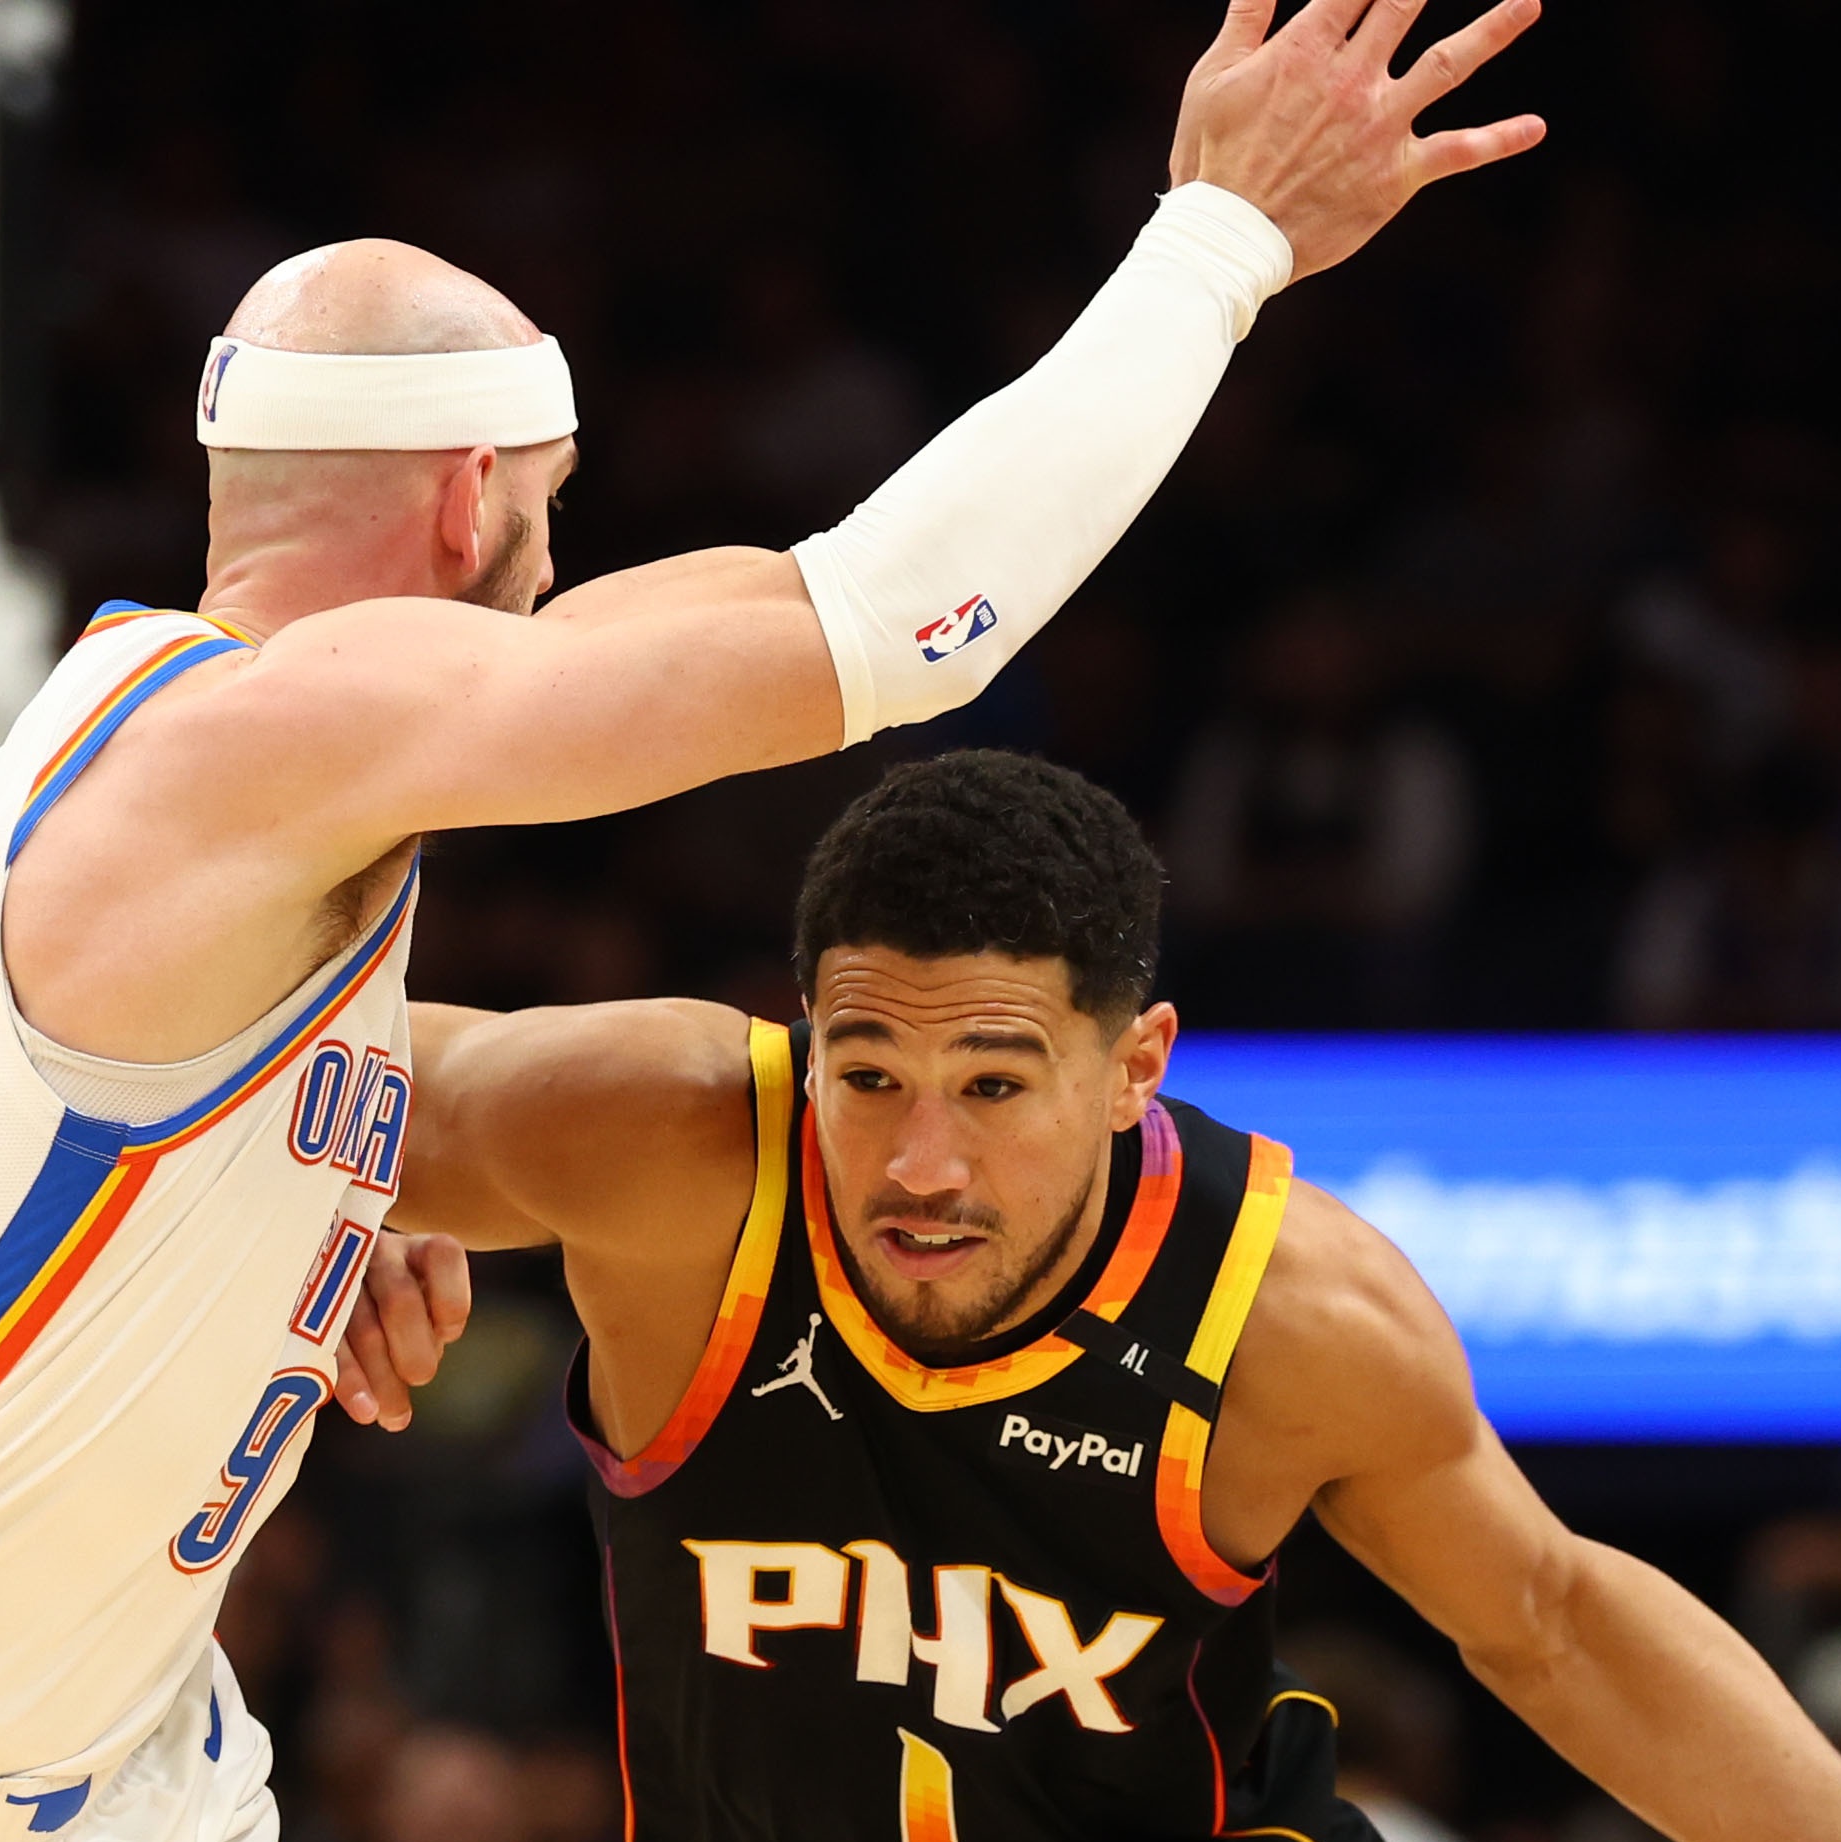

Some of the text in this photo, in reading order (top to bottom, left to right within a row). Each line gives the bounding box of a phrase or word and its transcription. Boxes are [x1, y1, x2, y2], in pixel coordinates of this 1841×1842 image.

[1118, 1341, 1149, 1377] AL
[168, 1366, 334, 1574] 9
[998, 1413, 1145, 1479] PayPal
[680, 1538, 1166, 1735] PHX
